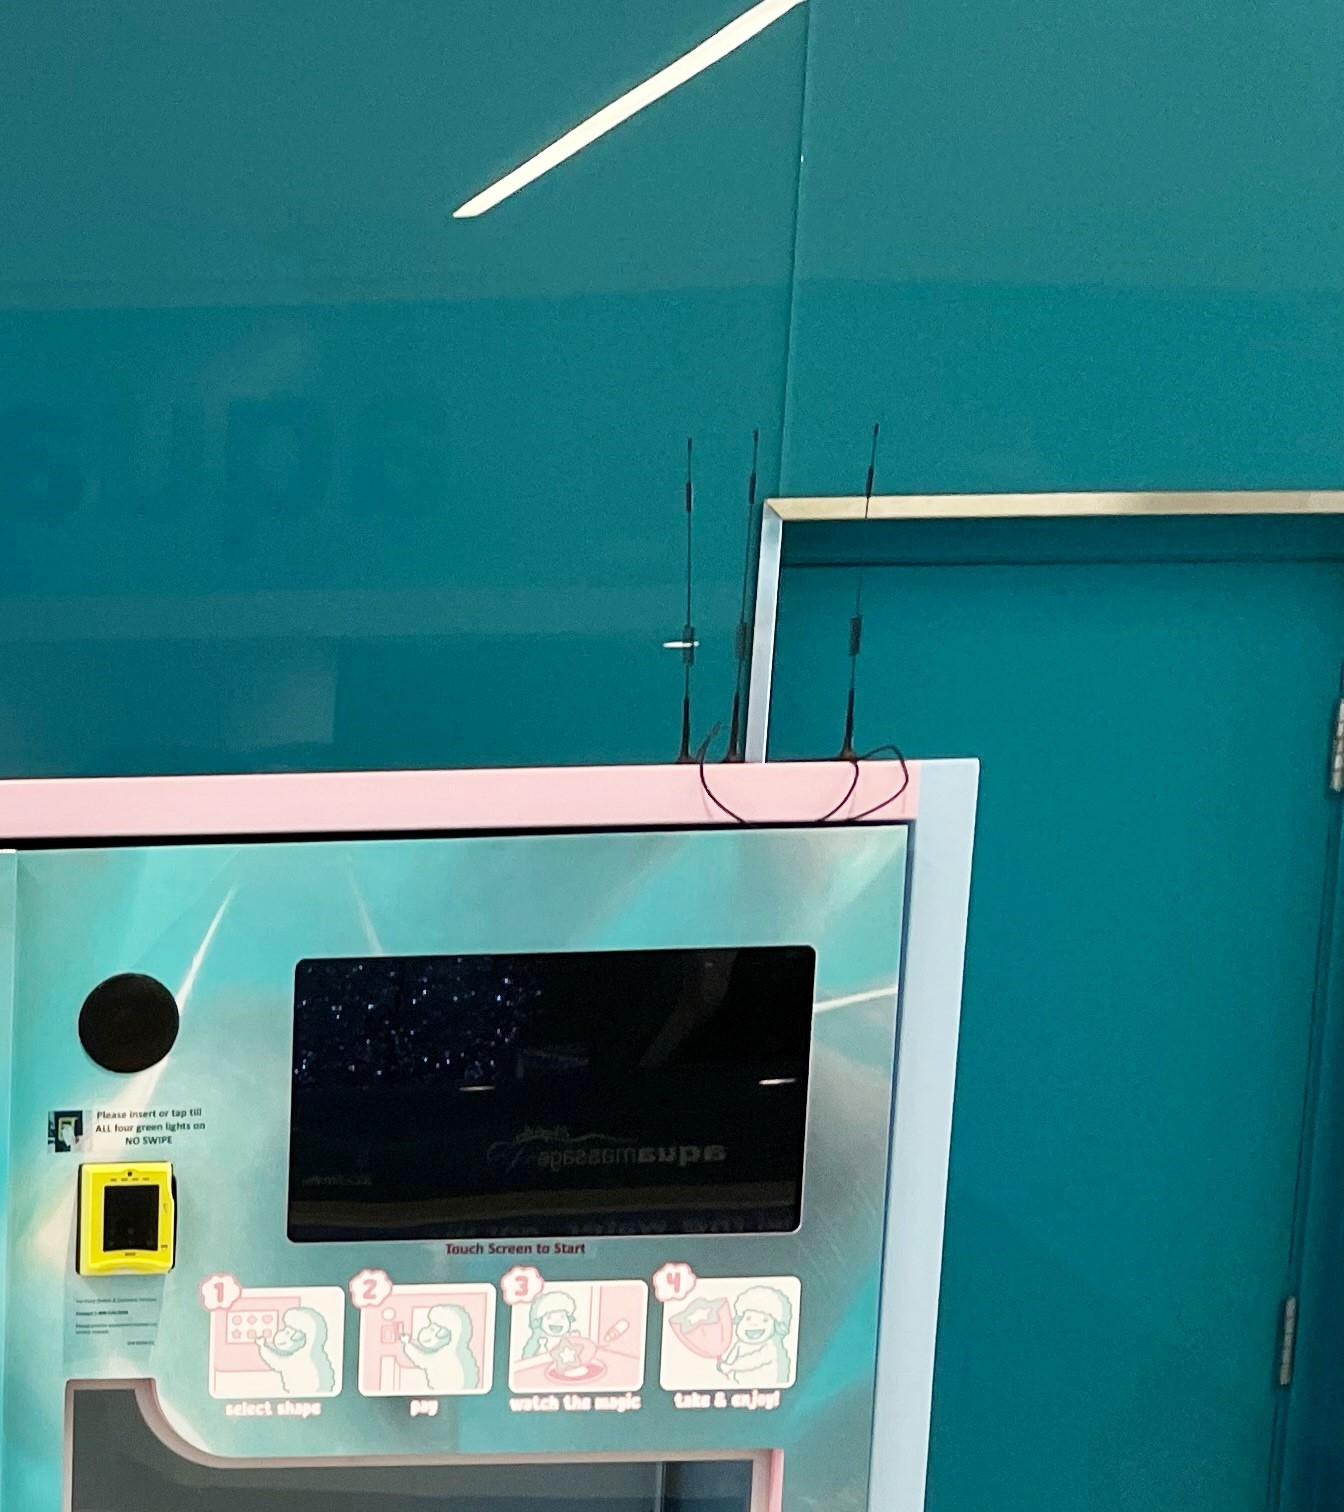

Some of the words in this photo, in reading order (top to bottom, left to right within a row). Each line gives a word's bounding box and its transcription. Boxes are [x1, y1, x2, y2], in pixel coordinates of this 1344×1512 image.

[97, 1111, 126, 1119] Please
[129, 1110, 156, 1119] insert
[158, 1110, 169, 1118] or
[171, 1109, 187, 1119] tap
[190, 1108, 201, 1117] till
[95, 1125, 111, 1133] ALL
[114, 1124, 133, 1132] four
[136, 1124, 163, 1133] green
[165, 1122, 190, 1133] lights
[193, 1122, 205, 1130] on
[125, 1137, 140, 1145] NO
[143, 1136, 172, 1145] SWIPE
[446, 1242, 484, 1255] Touch
[488, 1242, 532, 1254] Screen
[536, 1243, 550, 1254] to
[554, 1242, 585, 1254] Start
[363, 1279, 378, 1300] 2
[514, 1276, 528, 1296] 3
[666, 1273, 681, 1292] 4
[213, 1282, 224, 1303] 1
[410, 1399, 439, 1417] pay
[510, 1394, 560, 1412] watch
[562, 1394, 591, 1411] the
[595, 1392, 642, 1412] magic
[674, 1392, 710, 1409] take
[714, 1392, 727, 1408] &
[731, 1389, 780, 1410] enjoy!
[225, 1401, 271, 1416] select
[277, 1401, 321, 1418] shape
